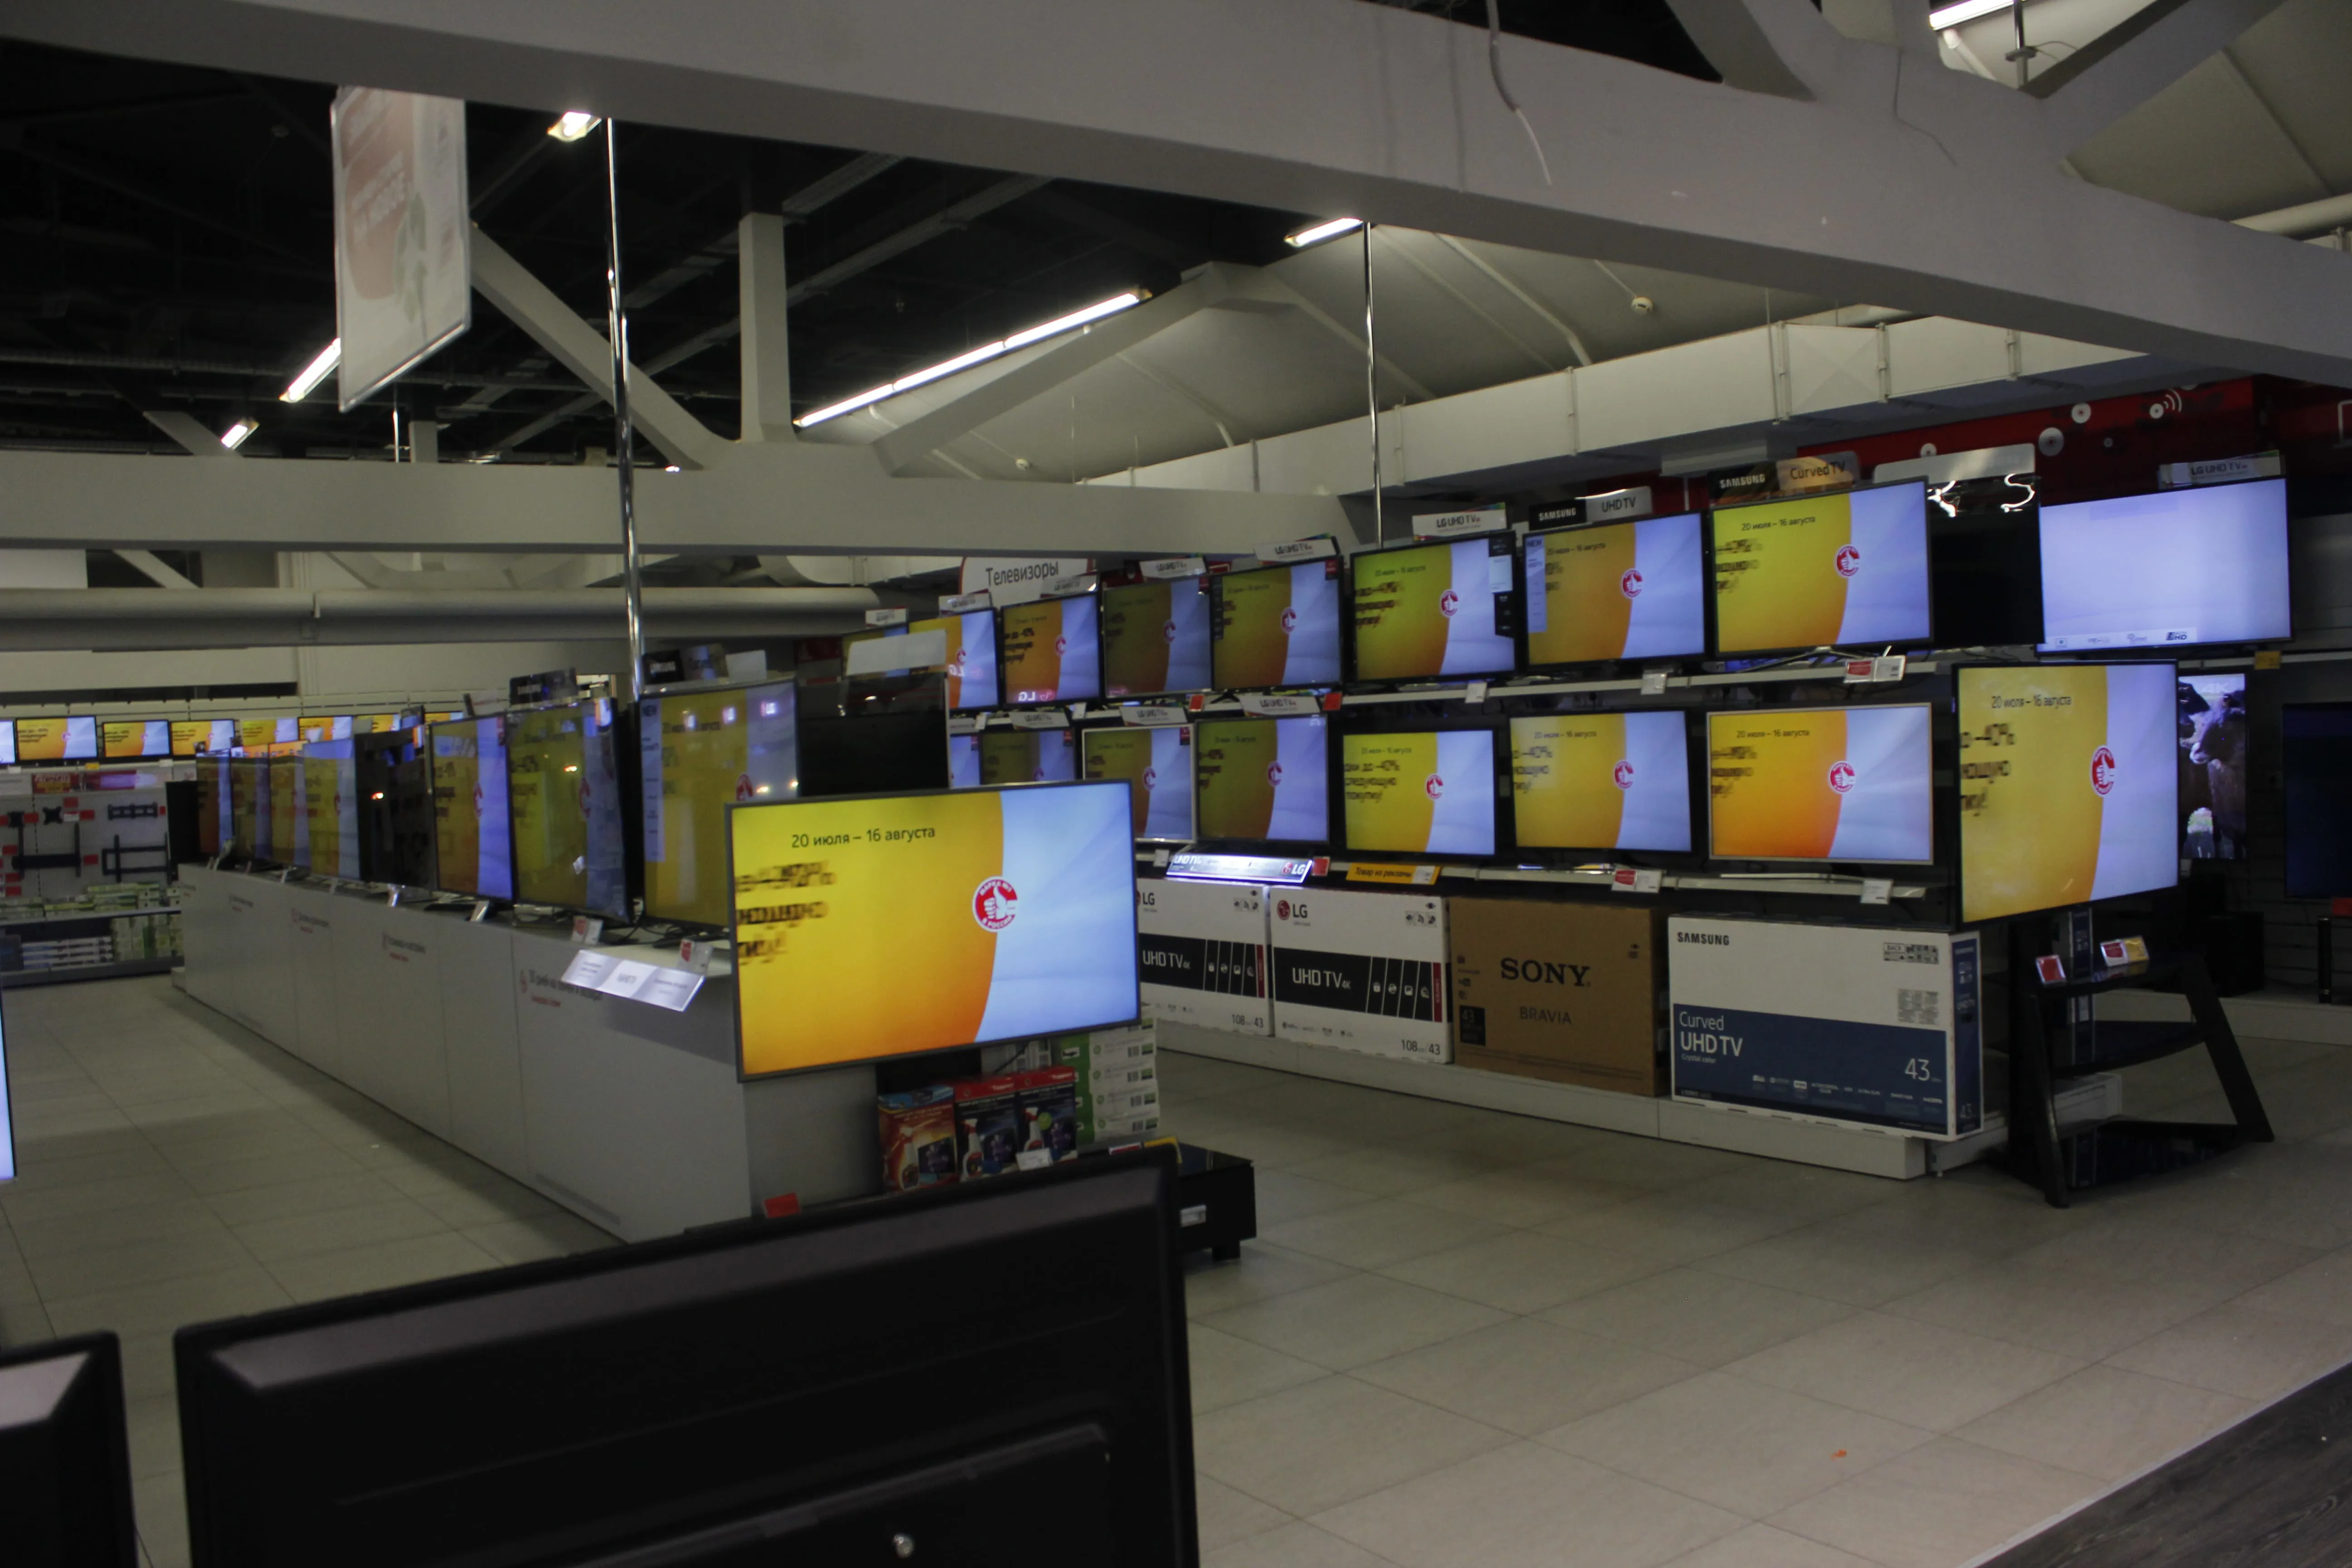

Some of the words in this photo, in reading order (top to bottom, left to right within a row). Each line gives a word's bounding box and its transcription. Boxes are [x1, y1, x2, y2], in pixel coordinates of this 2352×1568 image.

[1790, 464, 1829, 480] Curved
[1830, 461, 1845, 475] TV
[2191, 465, 2204, 475] LG
[2205, 463, 2226, 474] UHD
[2229, 462, 2241, 472] TV
[1719, 474, 1765, 489] SAMSUNG
[1602, 499, 1622, 513] UHD
[1623, 496, 1636, 509] TV
[1436, 518, 1447, 528] LG
[1448, 515, 1465, 526] UHD
[1465, 514, 1475, 524] TV
[1539, 508, 1577, 522] SAMSUNG
[985, 561, 1059, 588] Телевизоры
[1991, 696, 2002, 709] 20
[2004, 698, 2024, 708] июля
[2034, 694, 2042, 706] 16
[2044, 696, 2072, 710] августа
[1737, 730, 1746, 738] 20
[1773, 729, 1782, 737] 16
[792, 833, 808, 848] 20
[813, 833, 849, 846] июля
[866, 828, 881, 843] 16
[885, 827, 935, 845] августа
[1291, 863, 1306, 875] LG
[1356, 867, 1374, 877] Товар
[1382, 869, 1412, 878] рекламы
[1142, 892, 1155, 906] LG
[1293, 903, 1308, 919] LG
[1678, 931, 1730, 946] SAMSUNG
[1142, 950, 1167, 967] UHD
[1167, 952, 1183, 969] TV
[1182, 960, 1191, 970] 4K
[1292, 967, 1321, 986] UHD
[1323, 970, 1343, 989] TV
[1341, 980, 1352, 990] 4K
[1500, 957, 1590, 987] SONY
[1232, 1014, 1245, 1026] 108
[1254, 1017, 1264, 1028] 43
[1519, 1006, 1573, 1025] BRAVIA
[1680, 1010, 1724, 1031] Curved
[1401, 1039, 1418, 1053] 108
[1428, 1044, 1441, 1056] 43
[1680, 1030, 1718, 1054] UHD
[1719, 1035, 1744, 1057] TV
[1681, 1054, 1702, 1063] Crystal
[1904, 1057, 1931, 1081] 43
[1960, 1102, 1972, 1120] 43
